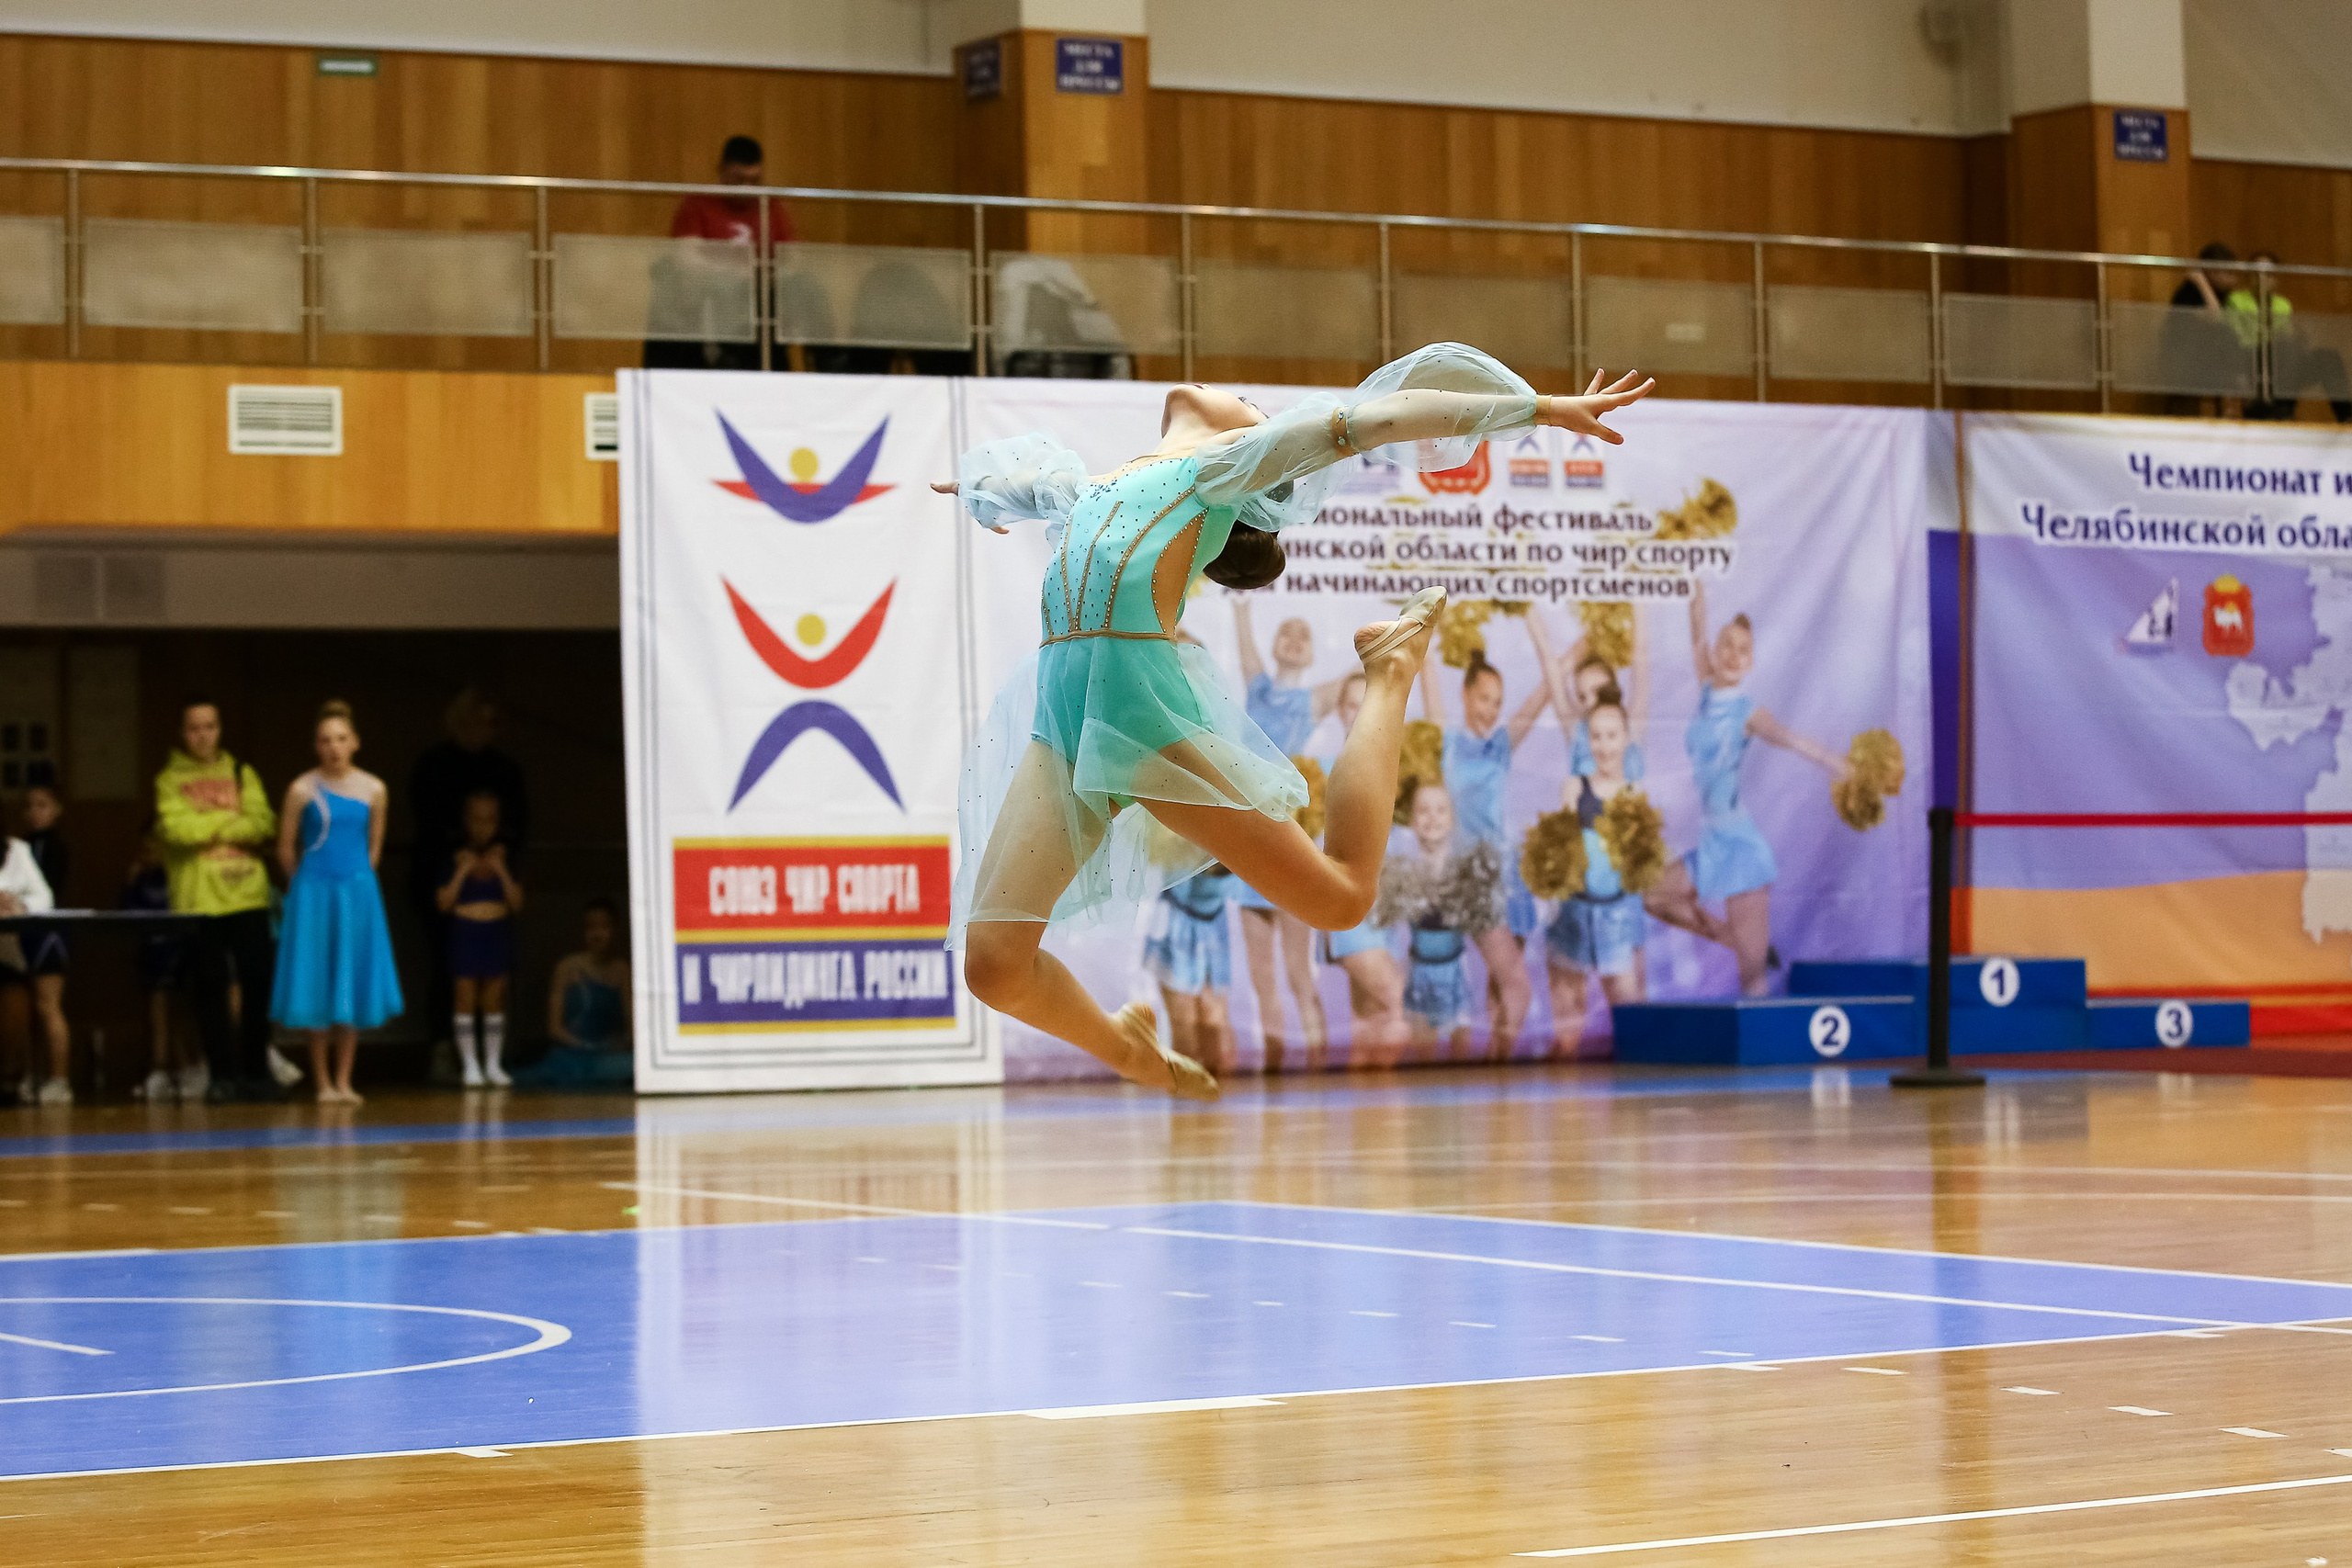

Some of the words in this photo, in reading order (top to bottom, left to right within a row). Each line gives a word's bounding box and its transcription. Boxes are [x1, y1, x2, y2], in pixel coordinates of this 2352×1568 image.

[2128, 452, 2323, 496] Чемпионат
[1315, 502, 1482, 529] иональный
[1493, 502, 1653, 536] фестиваль
[2022, 502, 2267, 547] Челябинской
[1396, 534, 1517, 563] области
[1527, 544, 1563, 564] по
[1572, 543, 1627, 570] чир
[1636, 544, 1732, 572] спорту
[1496, 577, 1690, 603] спортсменов
[1991, 967, 2007, 998] 1
[1820, 1015, 1840, 1046] 2
[2165, 1009, 2184, 1040] 3
